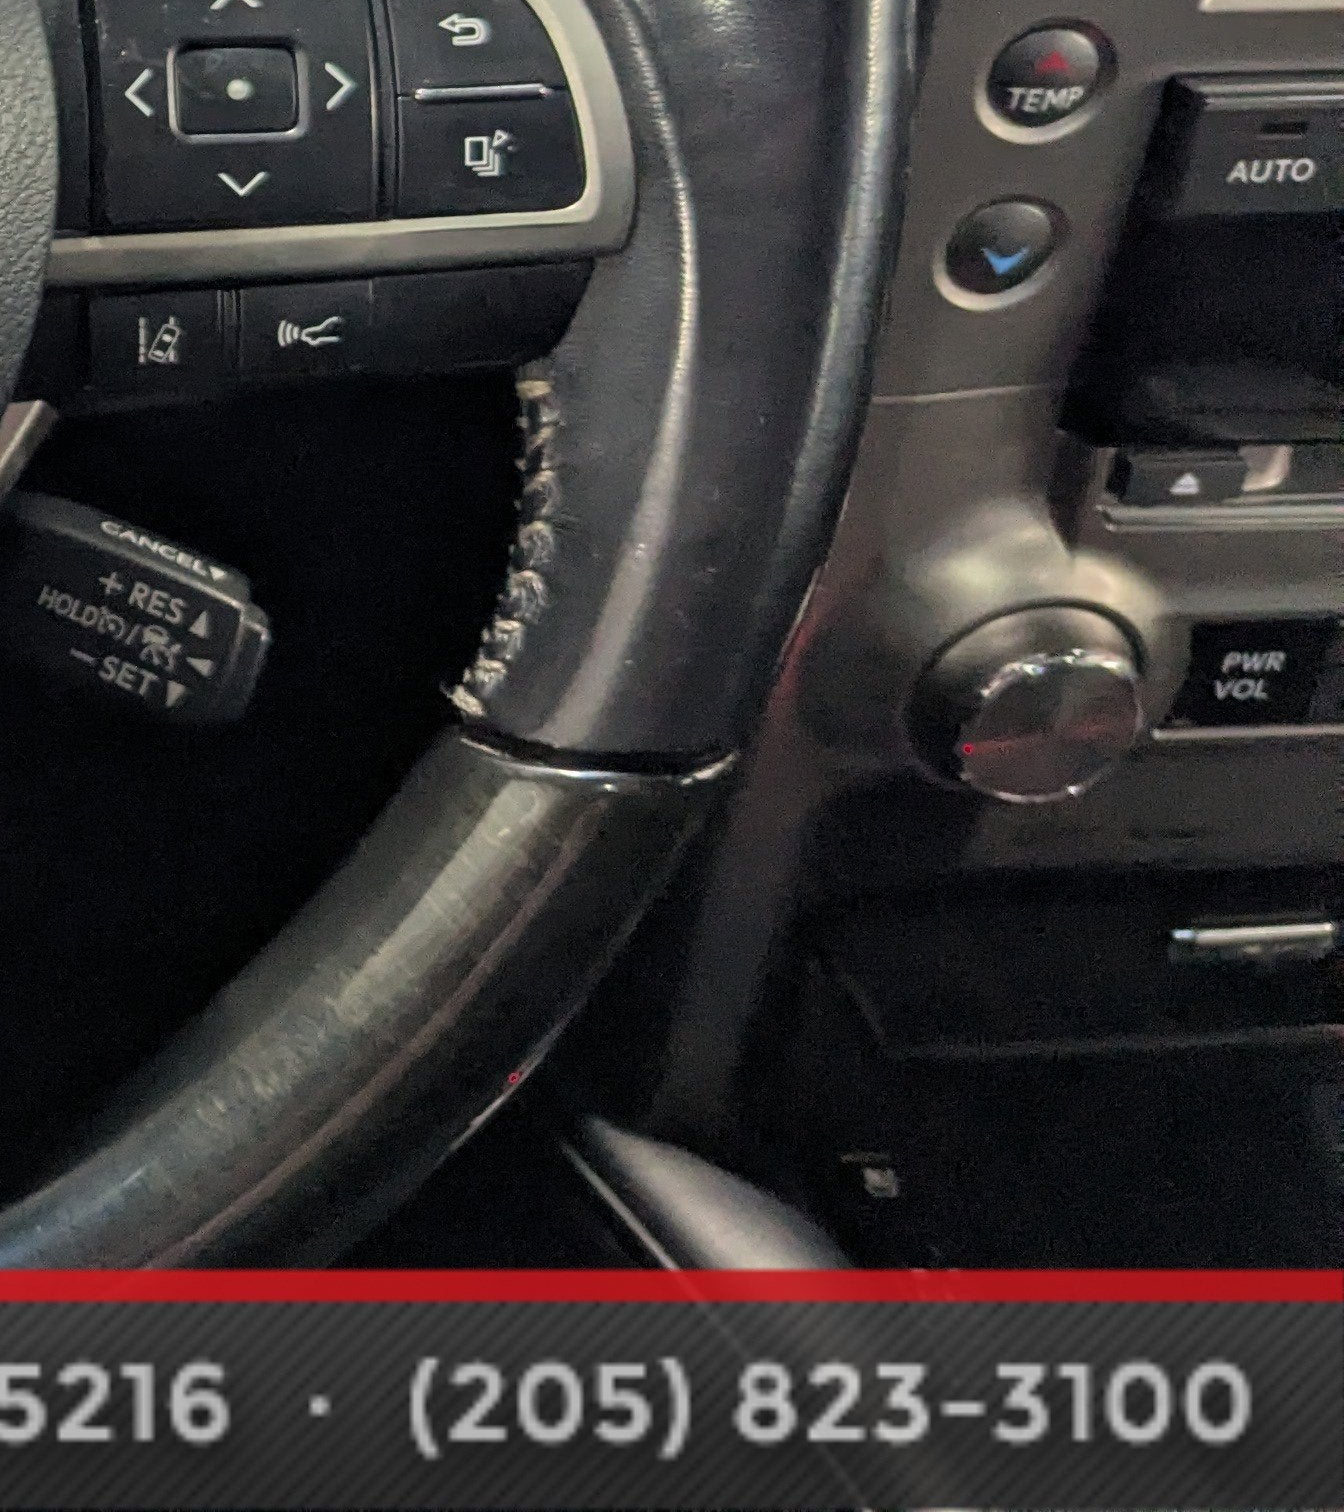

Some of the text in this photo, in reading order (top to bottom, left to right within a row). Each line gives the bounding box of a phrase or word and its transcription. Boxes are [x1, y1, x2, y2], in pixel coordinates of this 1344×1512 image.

[1005, 85, 1085, 115] TEMP
[1227, 158, 1317, 184] AUTO
[100, 520, 209, 576] CANCEL
[37, 586, 99, 626] HOLD
[127, 582, 186, 624] RES
[98, 655, 159, 696] SET
[1222, 651, 1287, 674] PWR
[1214, 679, 1269, 702] VOL
